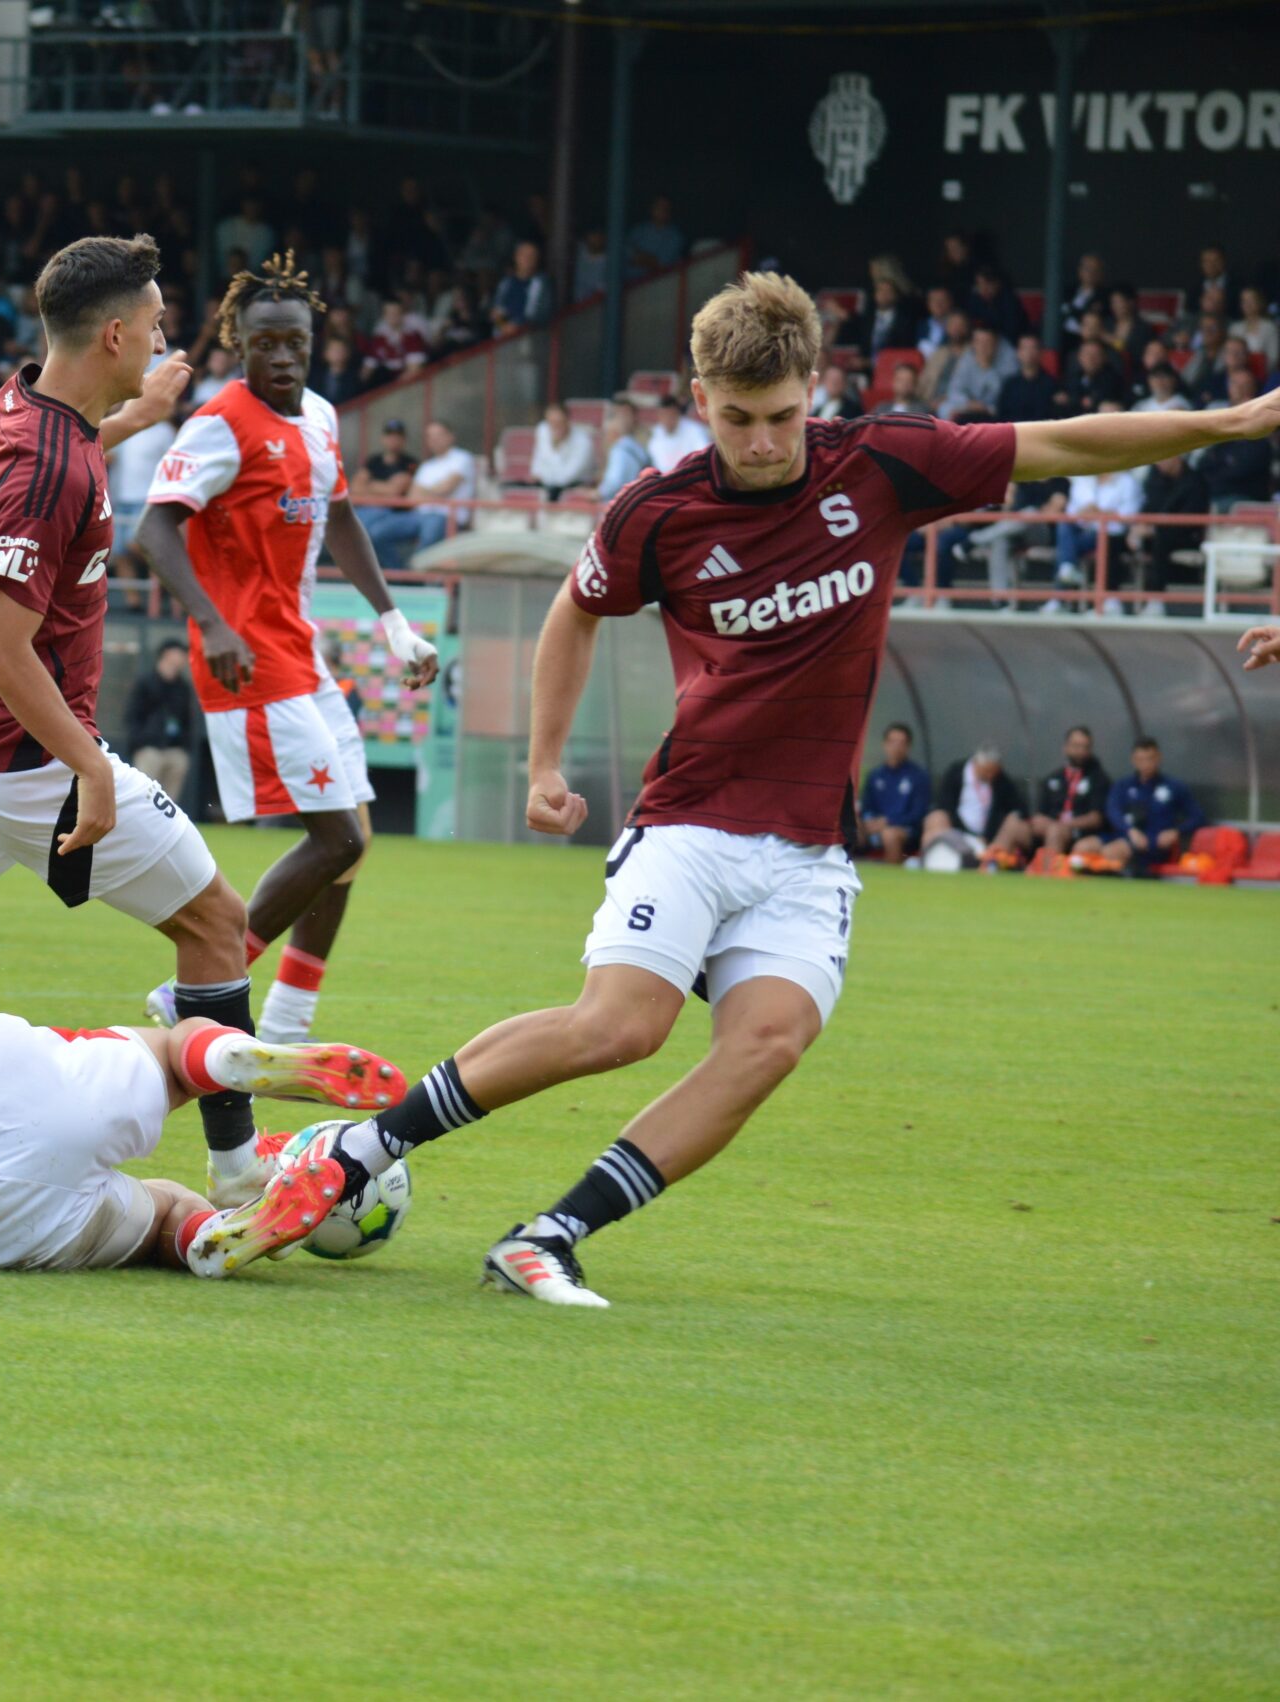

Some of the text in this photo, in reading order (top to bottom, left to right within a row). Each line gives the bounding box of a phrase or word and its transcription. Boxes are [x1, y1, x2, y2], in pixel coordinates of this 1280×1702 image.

[945, 94, 1024, 152] FK
[819, 493, 860, 538] S
[709, 561, 874, 635] Betano
[153, 791, 176, 818] S
[628, 903, 655, 931] S
